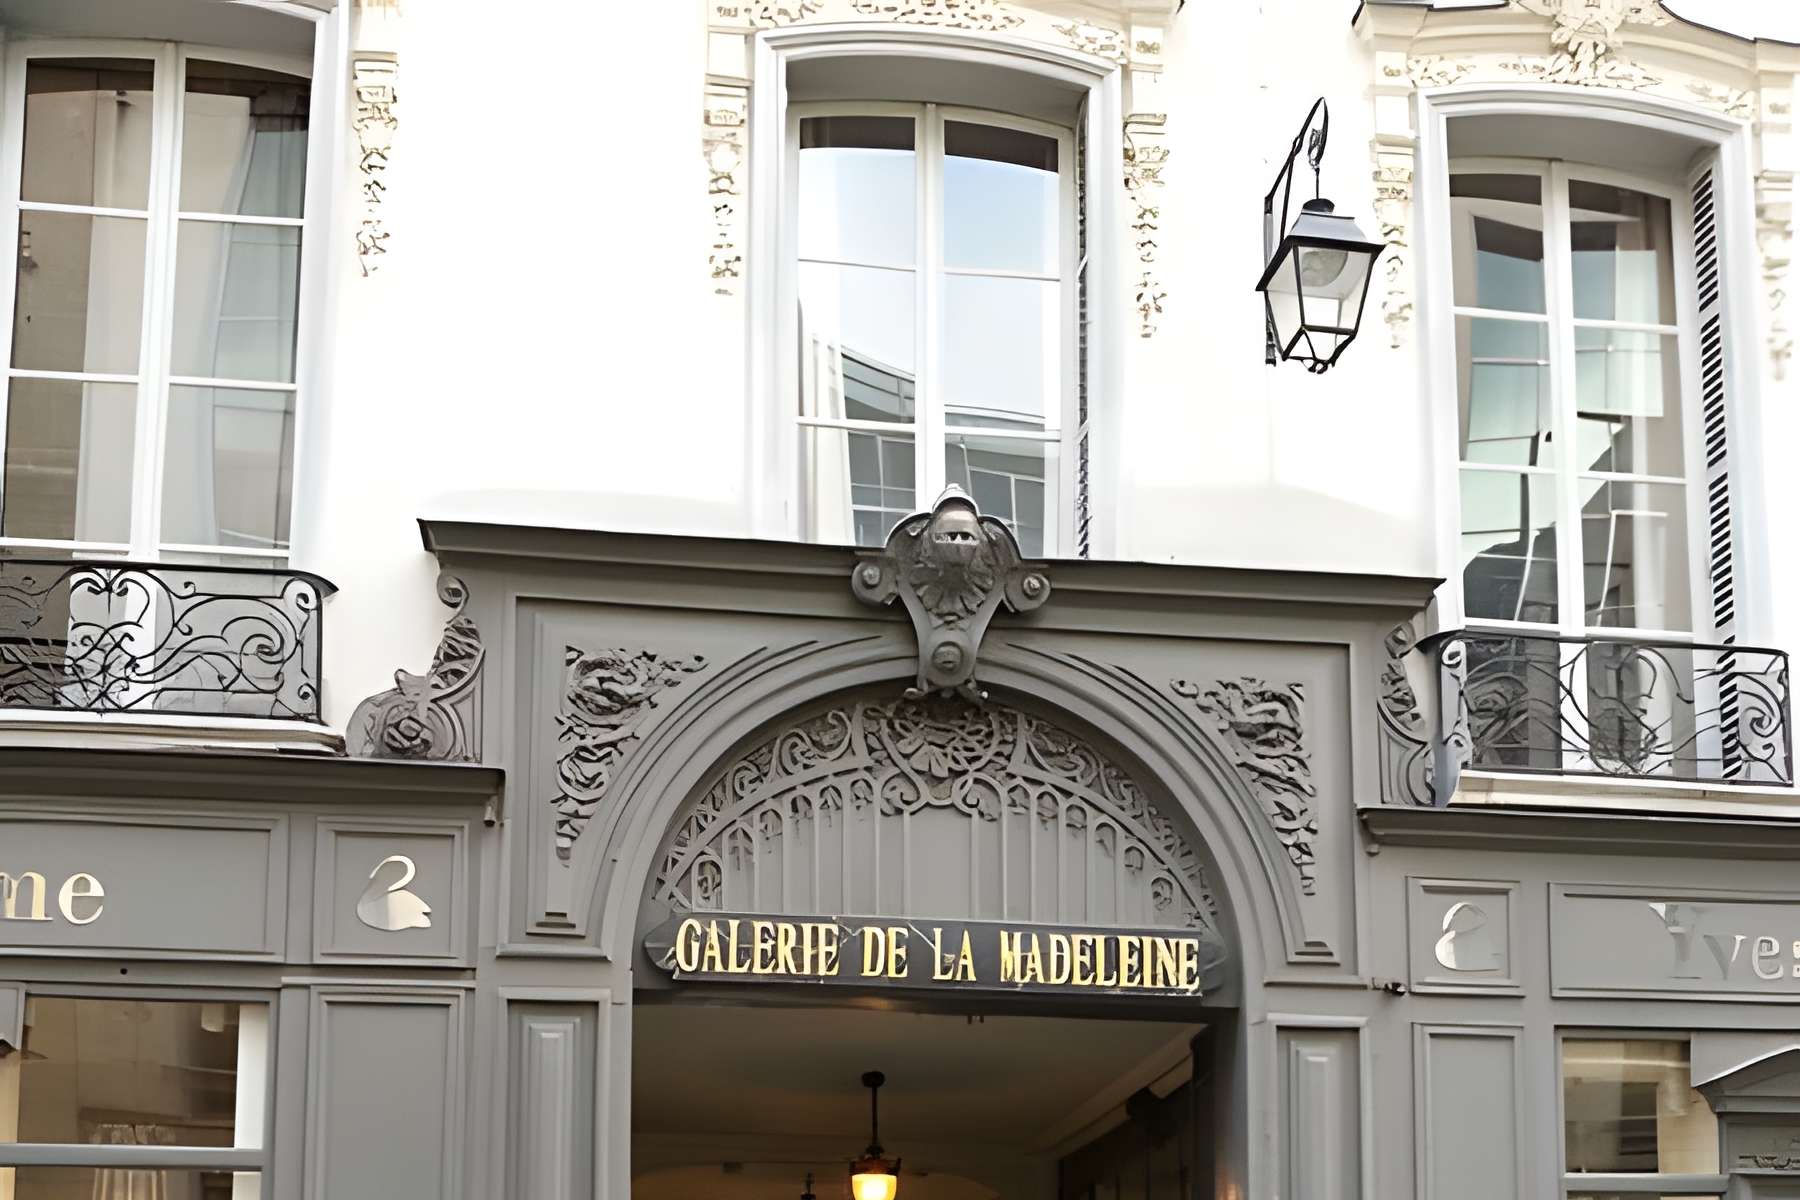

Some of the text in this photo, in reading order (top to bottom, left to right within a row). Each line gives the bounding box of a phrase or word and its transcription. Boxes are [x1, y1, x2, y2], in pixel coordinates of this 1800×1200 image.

[675, 917, 1201, 990] GALERIE DE LA MADELEINE
